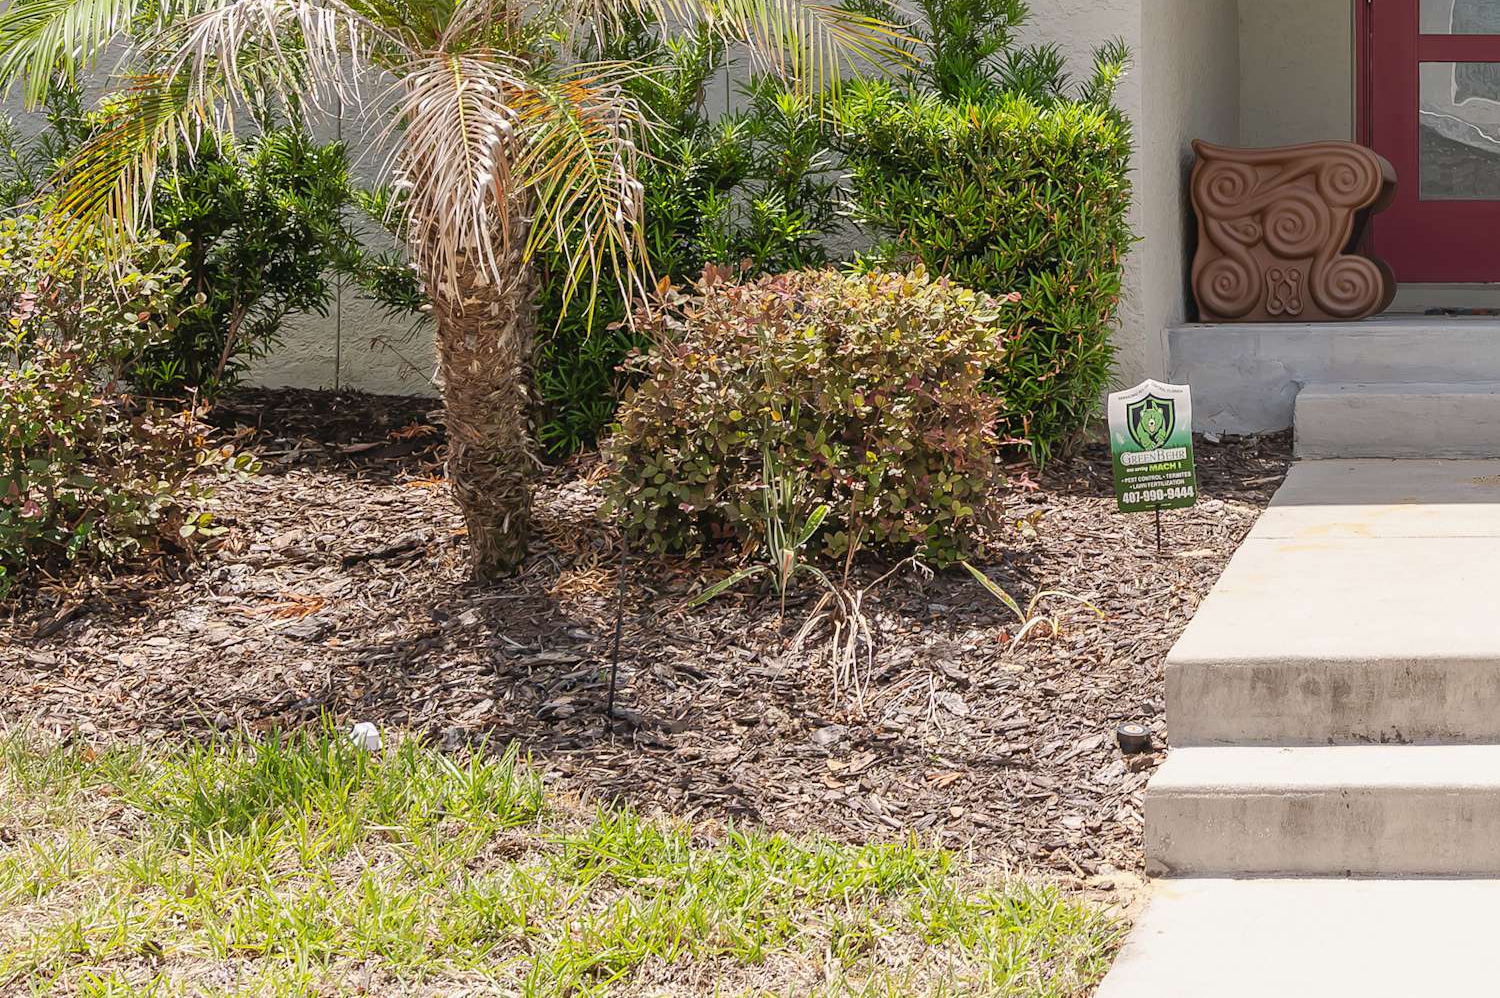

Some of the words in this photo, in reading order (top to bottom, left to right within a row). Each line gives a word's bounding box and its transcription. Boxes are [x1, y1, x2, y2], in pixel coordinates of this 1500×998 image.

[1149, 463, 1176, 471] MACH
[1148, 480, 1184, 488] FERTILIZATION
[1122, 486, 1194, 503] 407-990-9444
